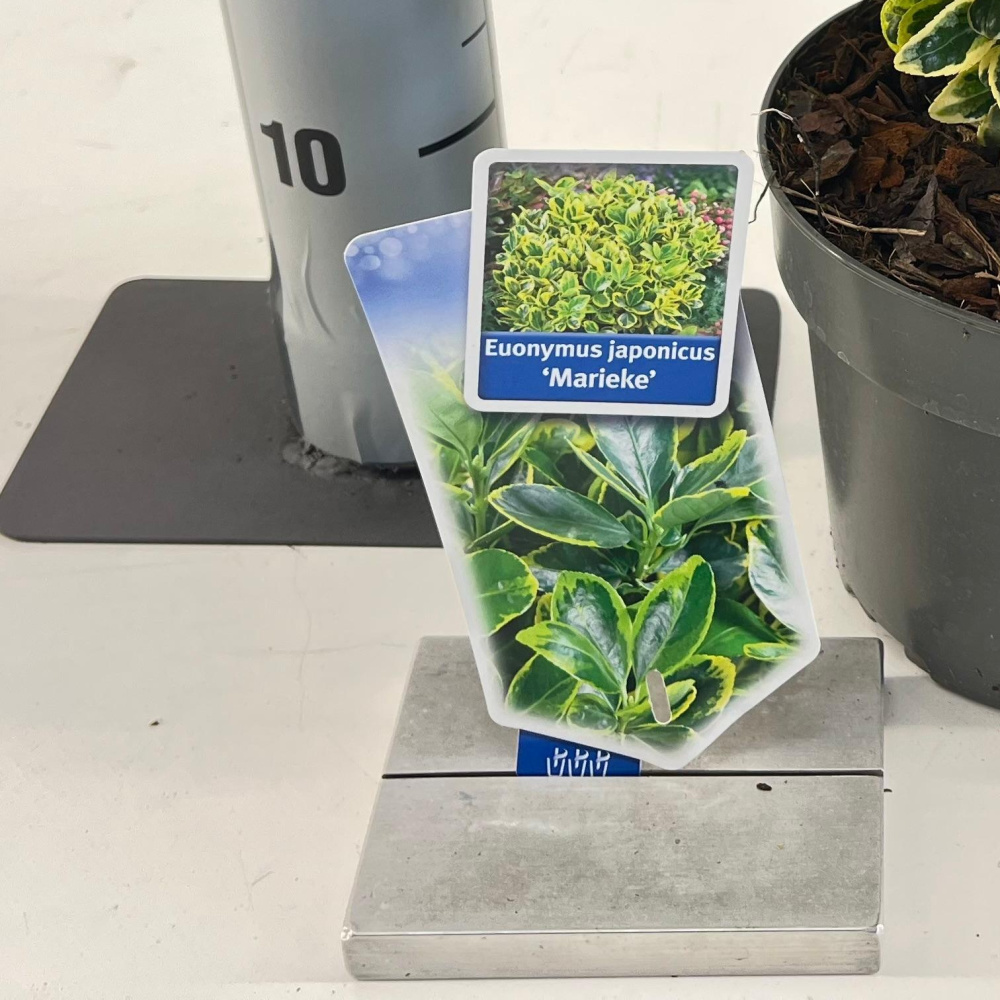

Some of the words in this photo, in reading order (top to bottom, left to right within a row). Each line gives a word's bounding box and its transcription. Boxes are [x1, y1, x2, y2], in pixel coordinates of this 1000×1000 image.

[260, 120, 347, 196] 10
[485, 338, 602, 361] Euonymus
[607, 340, 715, 363] japonicus
